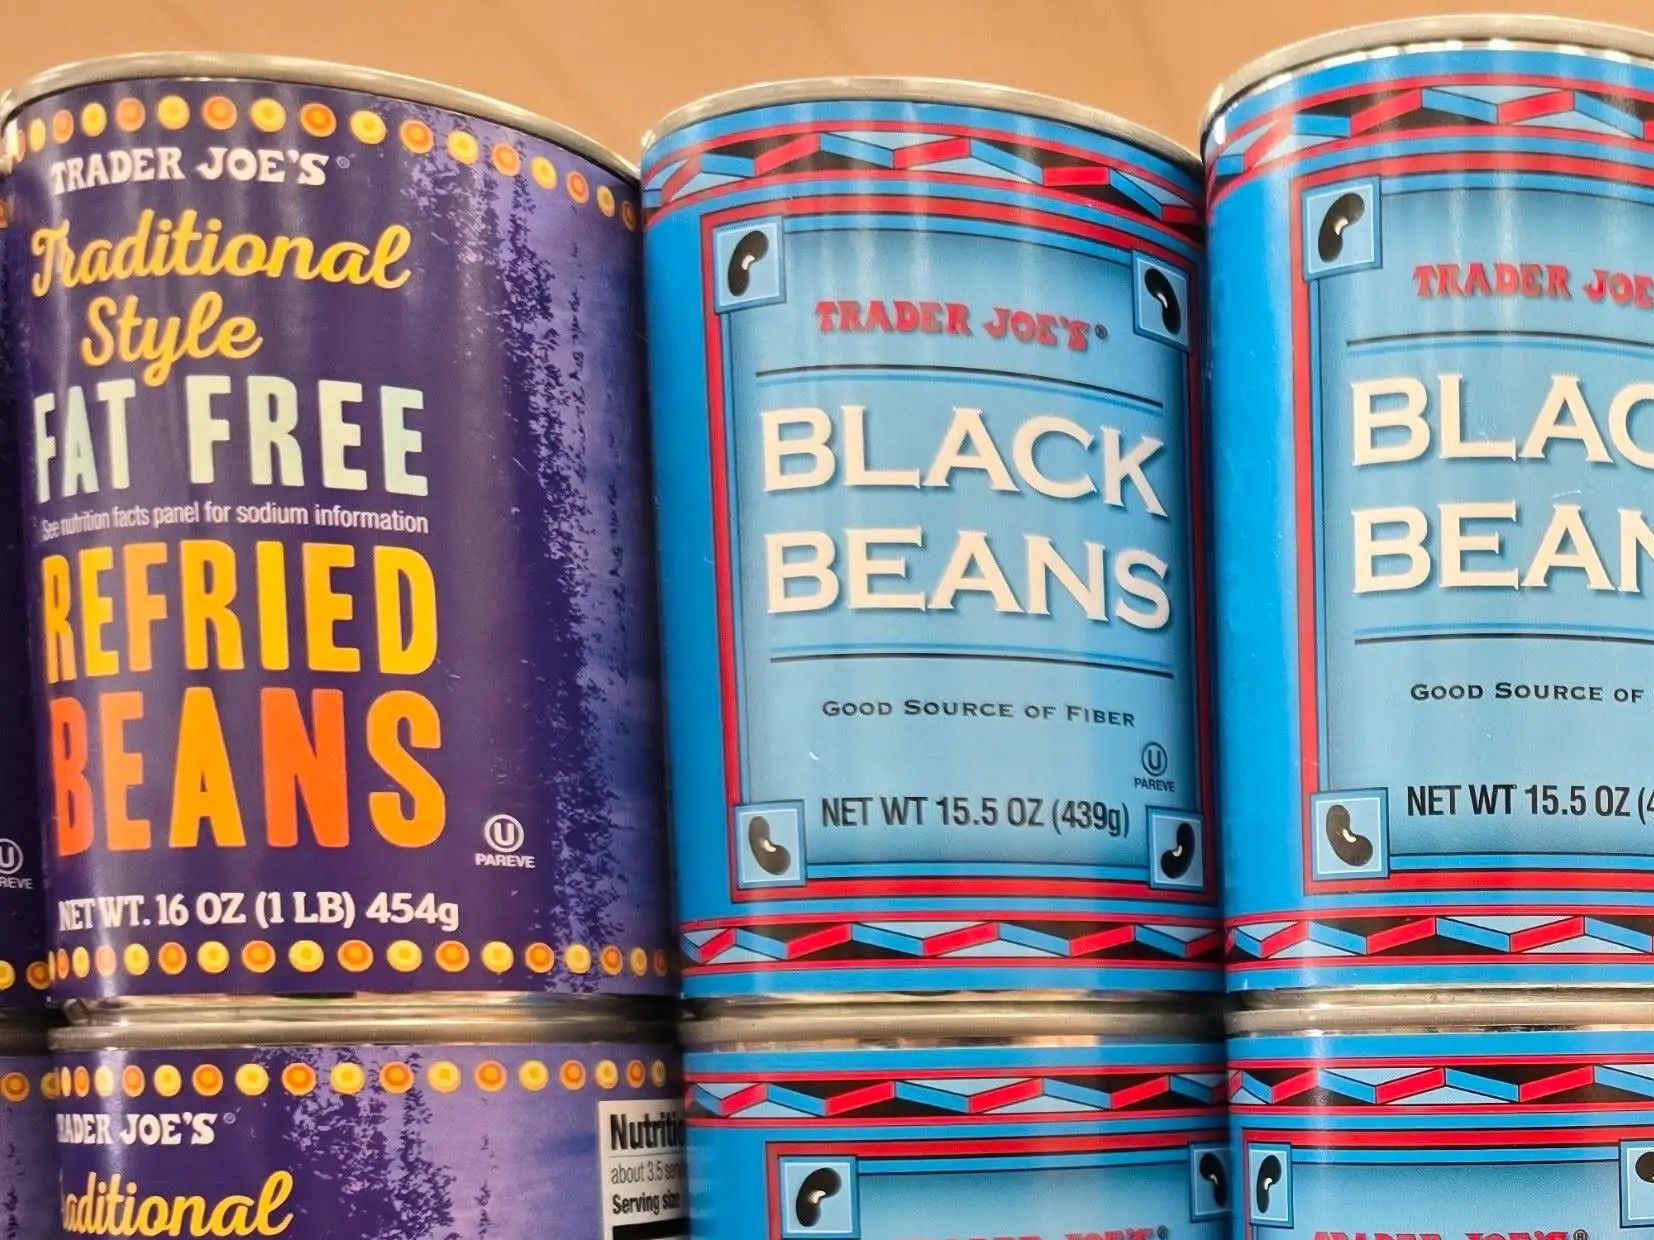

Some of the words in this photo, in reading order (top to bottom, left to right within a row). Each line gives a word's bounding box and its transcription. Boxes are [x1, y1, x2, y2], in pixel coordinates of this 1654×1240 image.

[50, 147, 185, 196] TRADER
[30, 208, 411, 297] Traditional
[1413, 263, 1572, 299] TRADER
[815, 299, 970, 336] TRADER
[81, 290, 263, 387] Style
[33, 378, 136, 504] FAT
[186, 375, 429, 497] FREE
[760, 404, 1168, 518] BLACK
[60, 510, 109, 536] nutrition
[112, 505, 150, 528] facts
[153, 501, 199, 531] panel
[203, 500, 230, 523] for
[236, 502, 308, 525] sodium
[314, 504, 429, 534] information
[763, 525, 1170, 630] BEANS
[41, 539, 438, 684] REFRIED
[1410, 683, 1484, 701] GOOD
[1495, 682, 1603, 702] SOURCE
[822, 700, 894, 717] GOOD
[903, 698, 1014, 719] SOURCE
[1066, 705, 1136, 729] FIBER
[48, 686, 446, 857] BEANS
[822, 797, 873, 828] NET
[881, 797, 928, 827] WT
[936, 797, 997, 828] 15.5
[1007, 798, 1045, 828] OZ
[1052, 798, 1130, 837] (439g)
[1407, 784, 1461, 816] NET
[1468, 784, 1517, 816] WT
[1524, 785, 1586, 817] 15.5
[1595, 786, 1631, 817] OZ
[474, 852, 536, 869] PAREVE
[58, 898, 96, 932] NET
[156, 894, 187, 925] 16
[197, 892, 244, 925] OZ
[255, 892, 286, 928] (1
[294, 893, 357, 930] LB)
[366, 893, 459, 932] 454g
[610, 1162, 645, 1184] about
[612, 1192, 660, 1215] Serving
